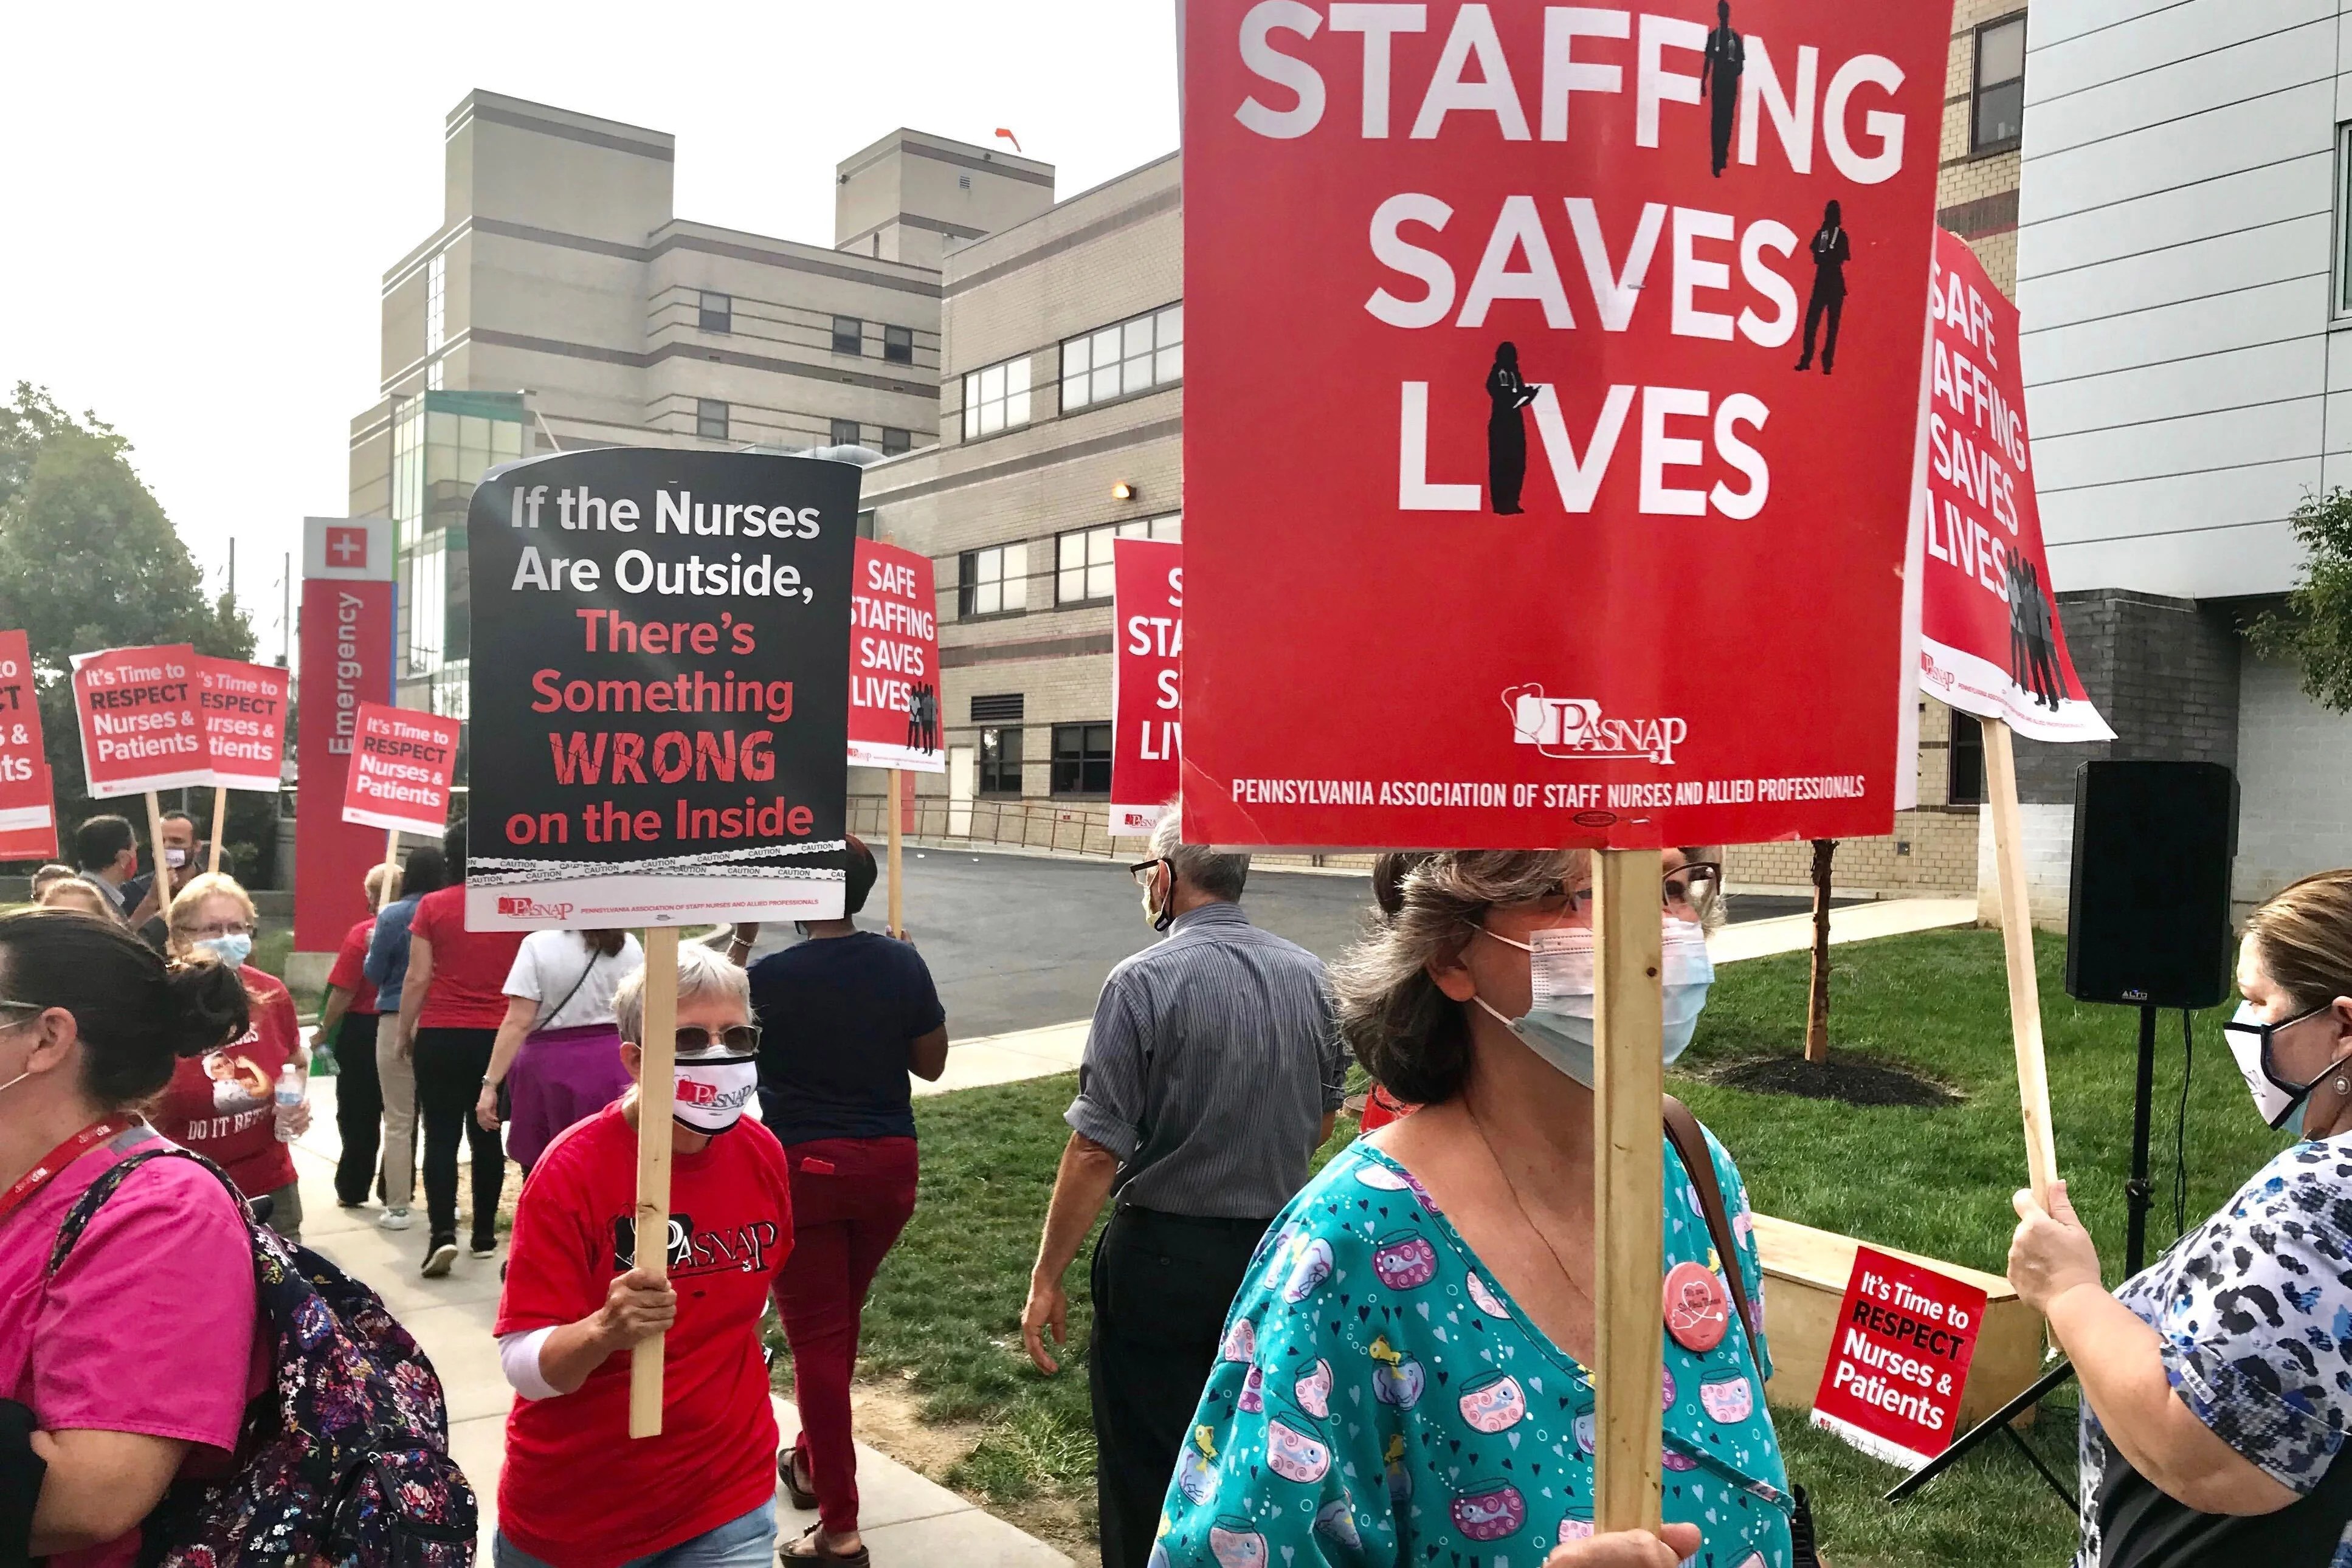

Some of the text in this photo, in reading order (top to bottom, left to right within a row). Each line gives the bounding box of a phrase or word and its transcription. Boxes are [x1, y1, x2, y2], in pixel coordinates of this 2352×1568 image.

[1364, 192, 1799, 349] SAVES
[1934, 339, 2027, 472] AFFING
[1931, 412, 2018, 536] SAVES
[511, 486, 821, 539] If the Nurses
[1926, 487, 2009, 603] LIVES
[511, 546, 813, 605] Are Outside,
[867, 559, 917, 600] SAFE
[576, 608, 756, 655] There's
[86, 662, 185, 687] It's Time to
[329, 591, 364, 755] Emergency
[861, 637, 925, 677] SAVES
[91, 684, 188, 710] RESPECT
[201, 692, 277, 715] ESPECT
[216, 673, 256, 693] Time
[261, 681, 278, 696] to
[531, 669, 793, 723] Something
[852, 675, 912, 713] LIVES
[94, 710, 195, 736] Nurses &
[207, 717, 275, 738] rses &
[367, 717, 449, 746] It's Time to
[1550, 703, 1688, 765] PASNAP
[97, 732, 199, 763] Patients
[209, 735, 273, 761] tients
[363, 737, 447, 765] RESPECT
[548, 730, 776, 785] WRONG
[359, 754, 444, 786] Nurses &
[356, 774, 441, 808] Patients
[1232, 775, 1865, 808] PENNSYLVANIA ASSOCIATION OF STAFF NURSES AND ALLIED PROFESSIONALS
[505, 796, 814, 845] on the Inside
[526, 870, 562, 879] CAUTION
[584, 865, 619, 873] CAUTION
[748, 848, 781, 856] CAUTION
[511, 899, 574, 920] PASNAP
[693, 1084, 751, 1107] PASNAP
[187, 1119, 207, 1141] DO
[212, 1116, 230, 1138] IT
[1861, 1271, 1969, 1329] It's Time to
[1852, 1299, 1965, 1361] RESPECT
[1843, 1328, 1953, 1397] Nurses &
[1833, 1360, 1945, 1431] Patients
